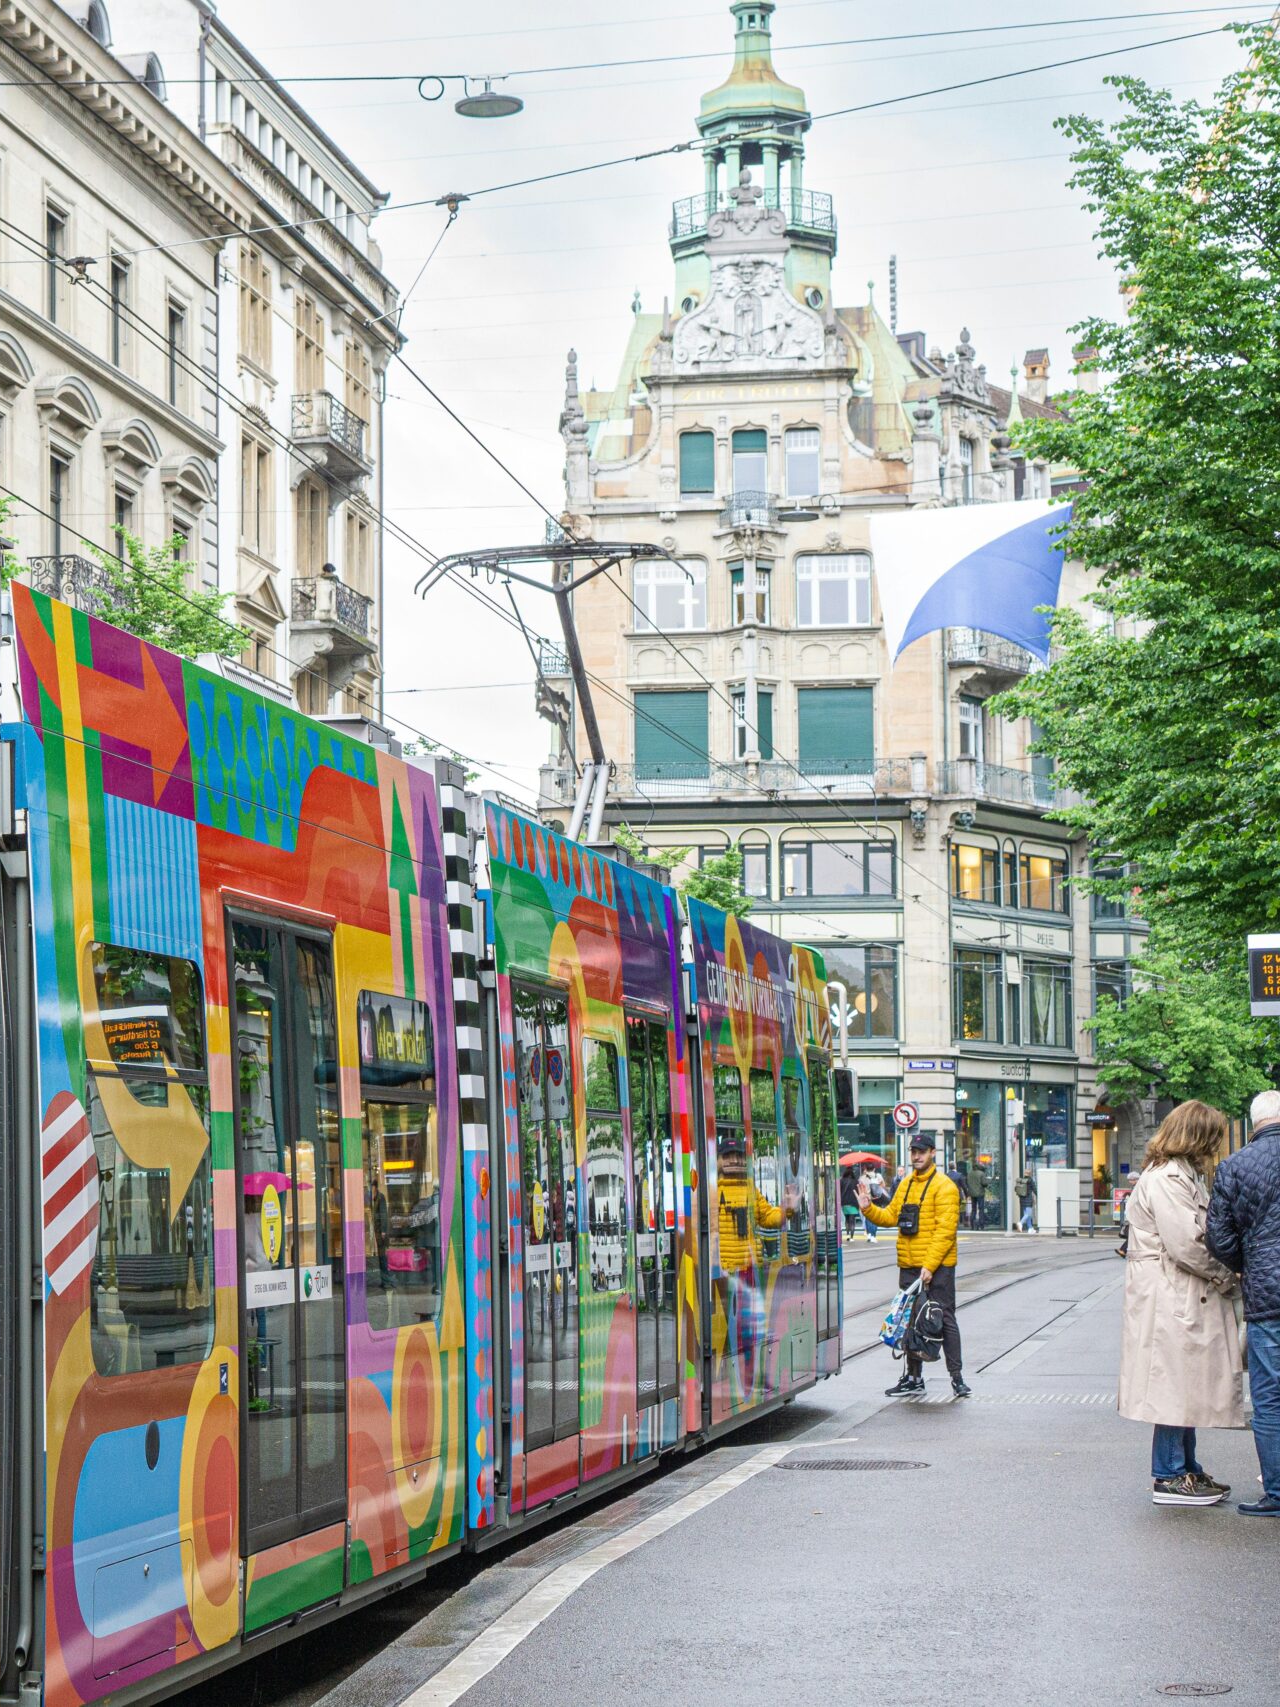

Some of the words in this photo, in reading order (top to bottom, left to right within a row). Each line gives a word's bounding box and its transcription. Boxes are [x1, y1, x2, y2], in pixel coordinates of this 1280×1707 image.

[1263, 954, 1272, 964] 17
[1263, 966, 1273, 974] 13
[1268, 976, 1274, 984] 6
[706, 960, 751, 1013] GEMEINSAM
[1264, 986, 1274, 995] 11
